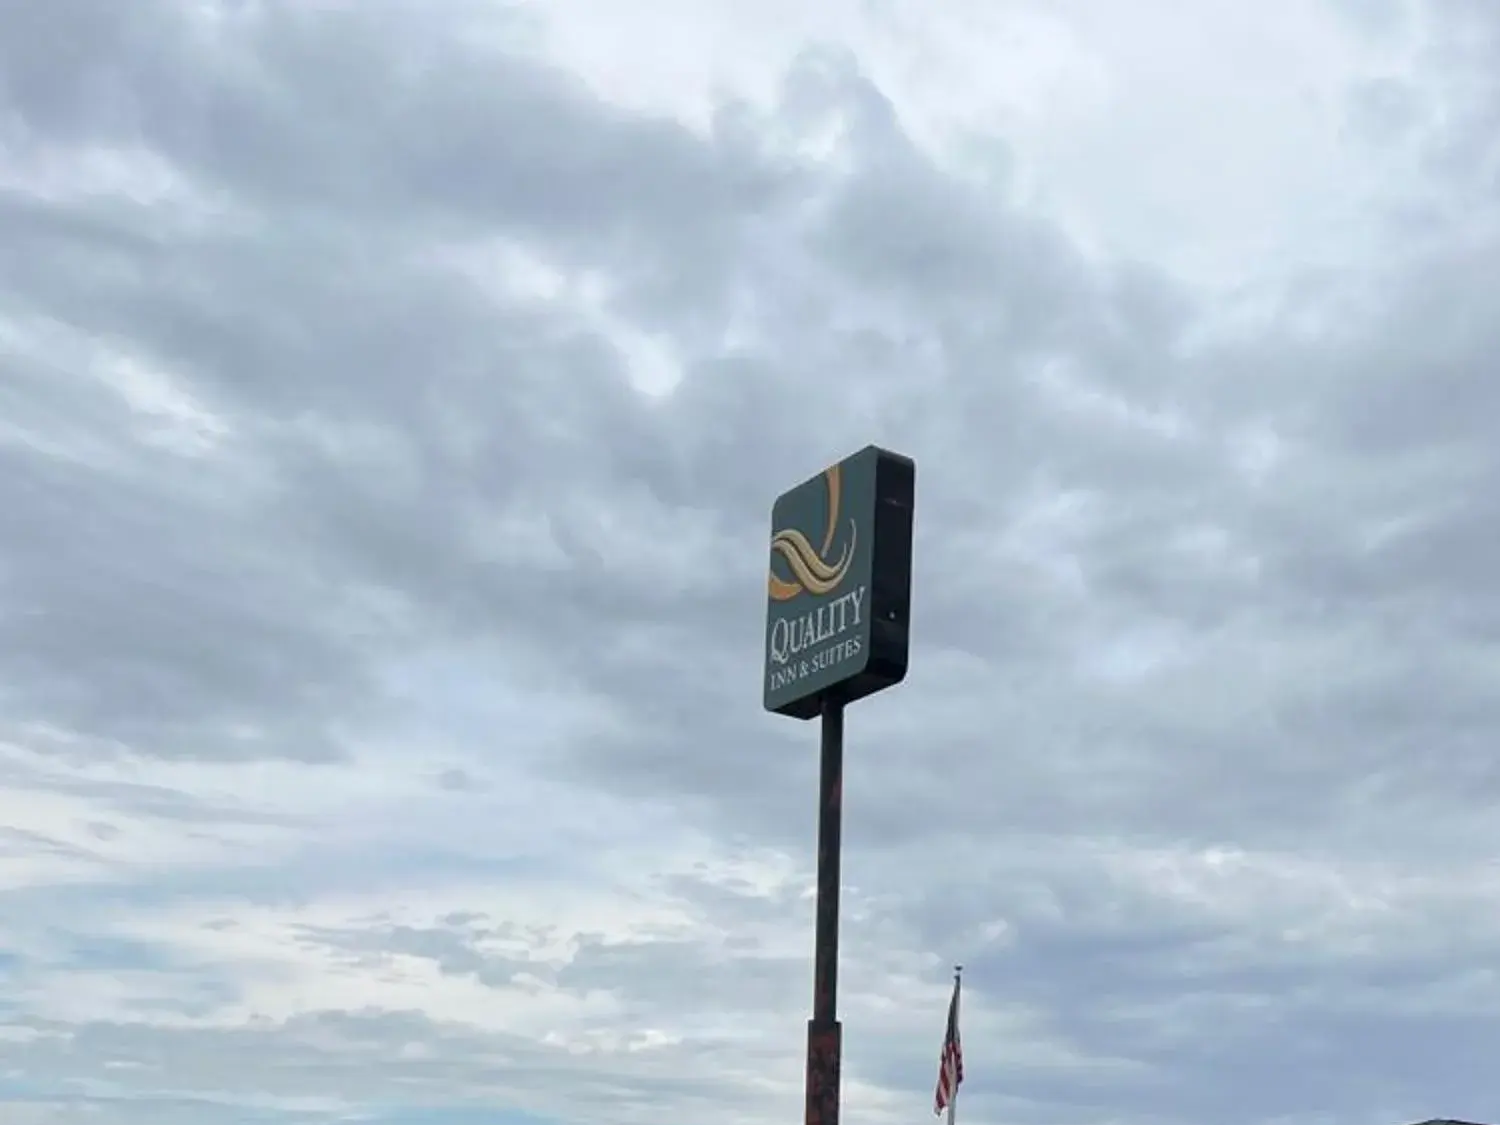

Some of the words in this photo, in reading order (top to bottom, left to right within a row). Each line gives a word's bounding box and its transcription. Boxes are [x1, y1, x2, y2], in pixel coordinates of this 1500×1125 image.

[771, 586, 866, 664] QUALITY
[770, 663, 797, 691] INN
[799, 660, 809, 678] &
[811, 635, 862, 673] SUITES
